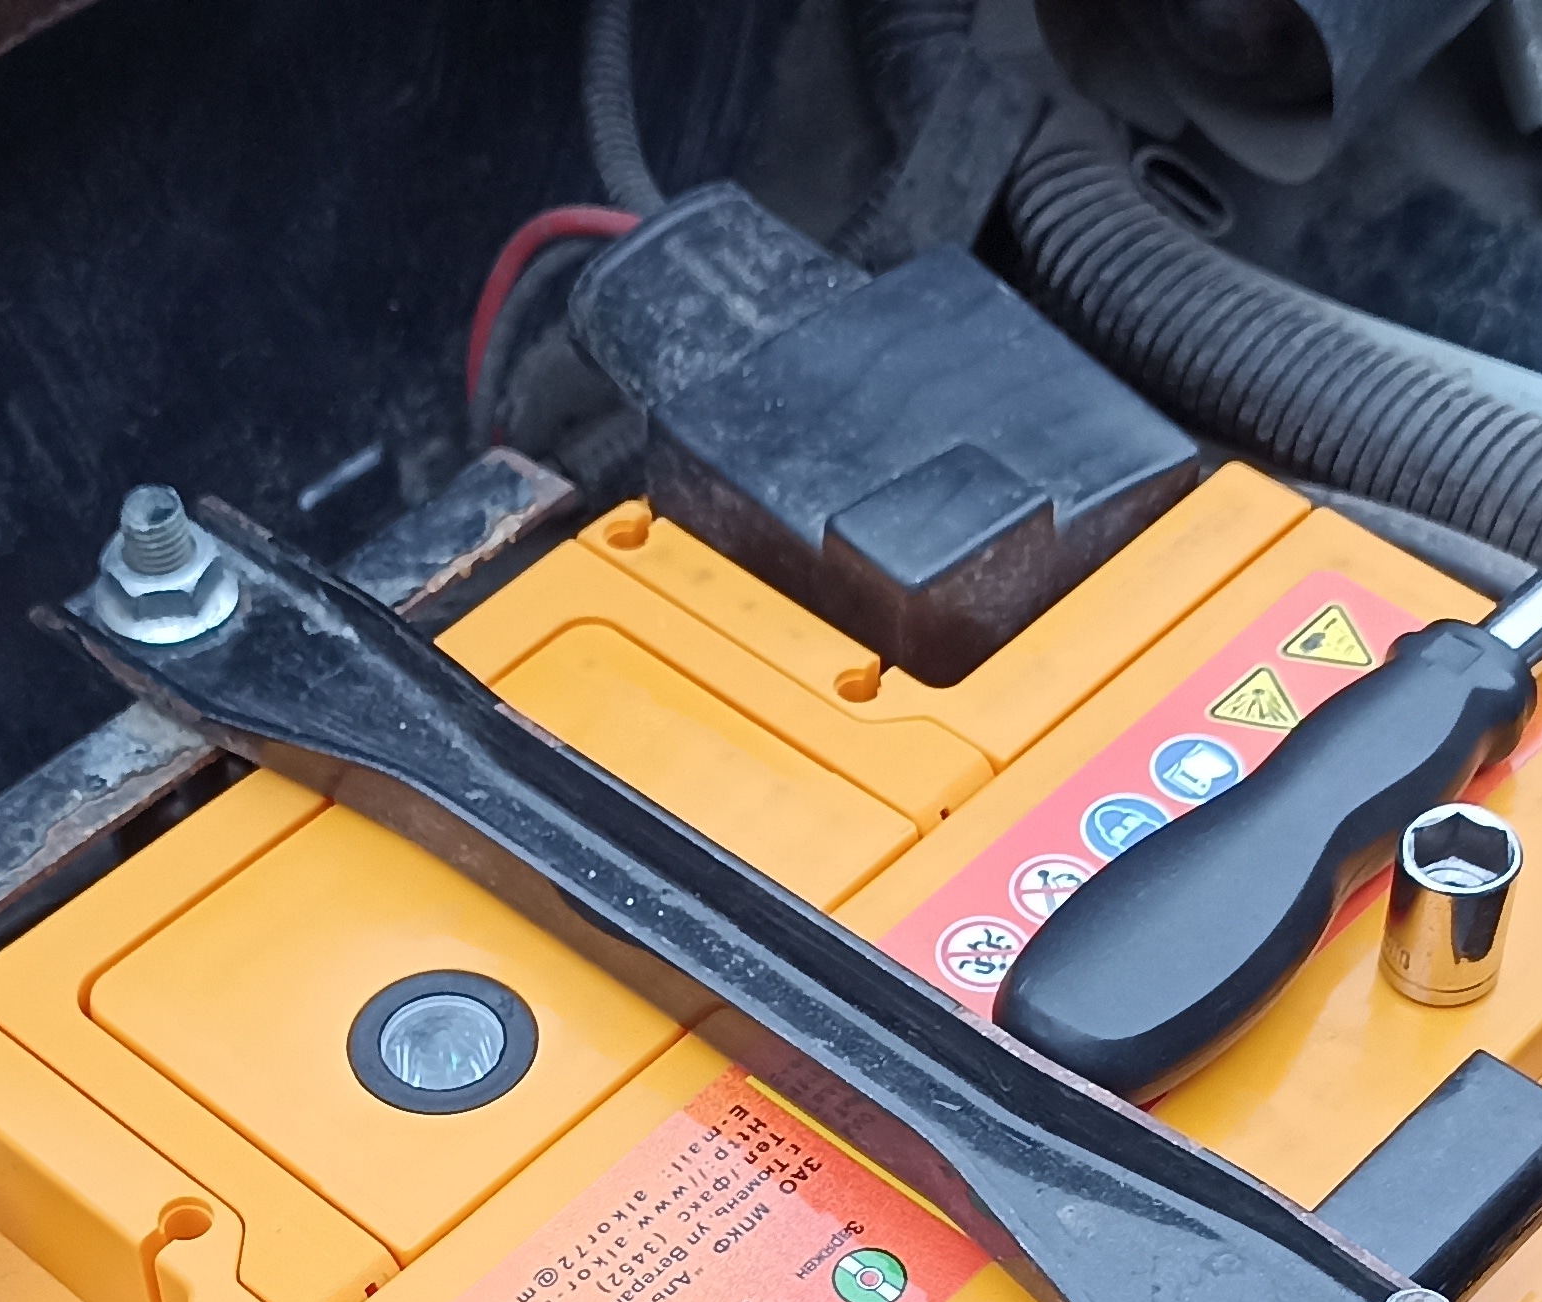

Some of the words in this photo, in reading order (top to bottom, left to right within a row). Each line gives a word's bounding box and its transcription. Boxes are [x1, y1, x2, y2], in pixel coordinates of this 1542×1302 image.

[777, 1155, 823, 1195] ЗАО
[711, 1201, 771, 1254] МПКФ
[594, 1231, 668, 1294] (3452)
